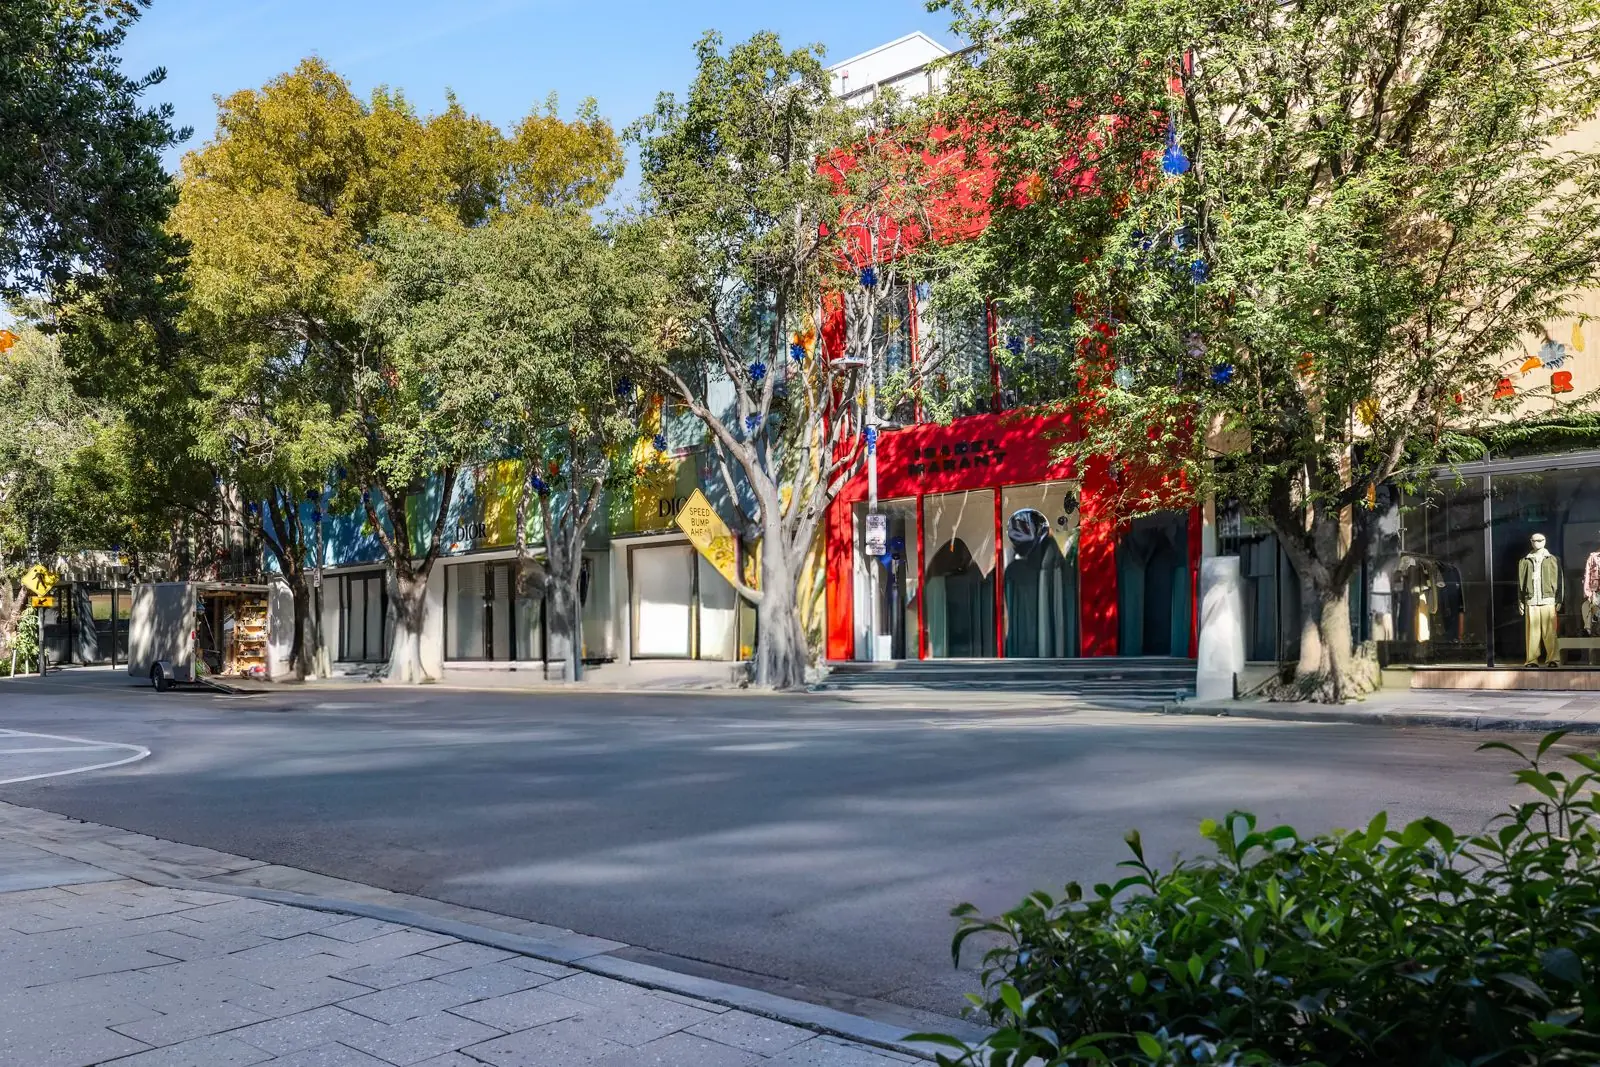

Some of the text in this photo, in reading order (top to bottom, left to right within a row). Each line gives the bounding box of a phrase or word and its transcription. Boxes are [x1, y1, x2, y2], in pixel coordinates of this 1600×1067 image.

[908, 451, 1006, 476] MARANT
[658, 496, 688, 517] DIO
[689, 507, 710, 517] SPEED
[456, 522, 487, 541] DIOR
[691, 518, 710, 527] BUMP
